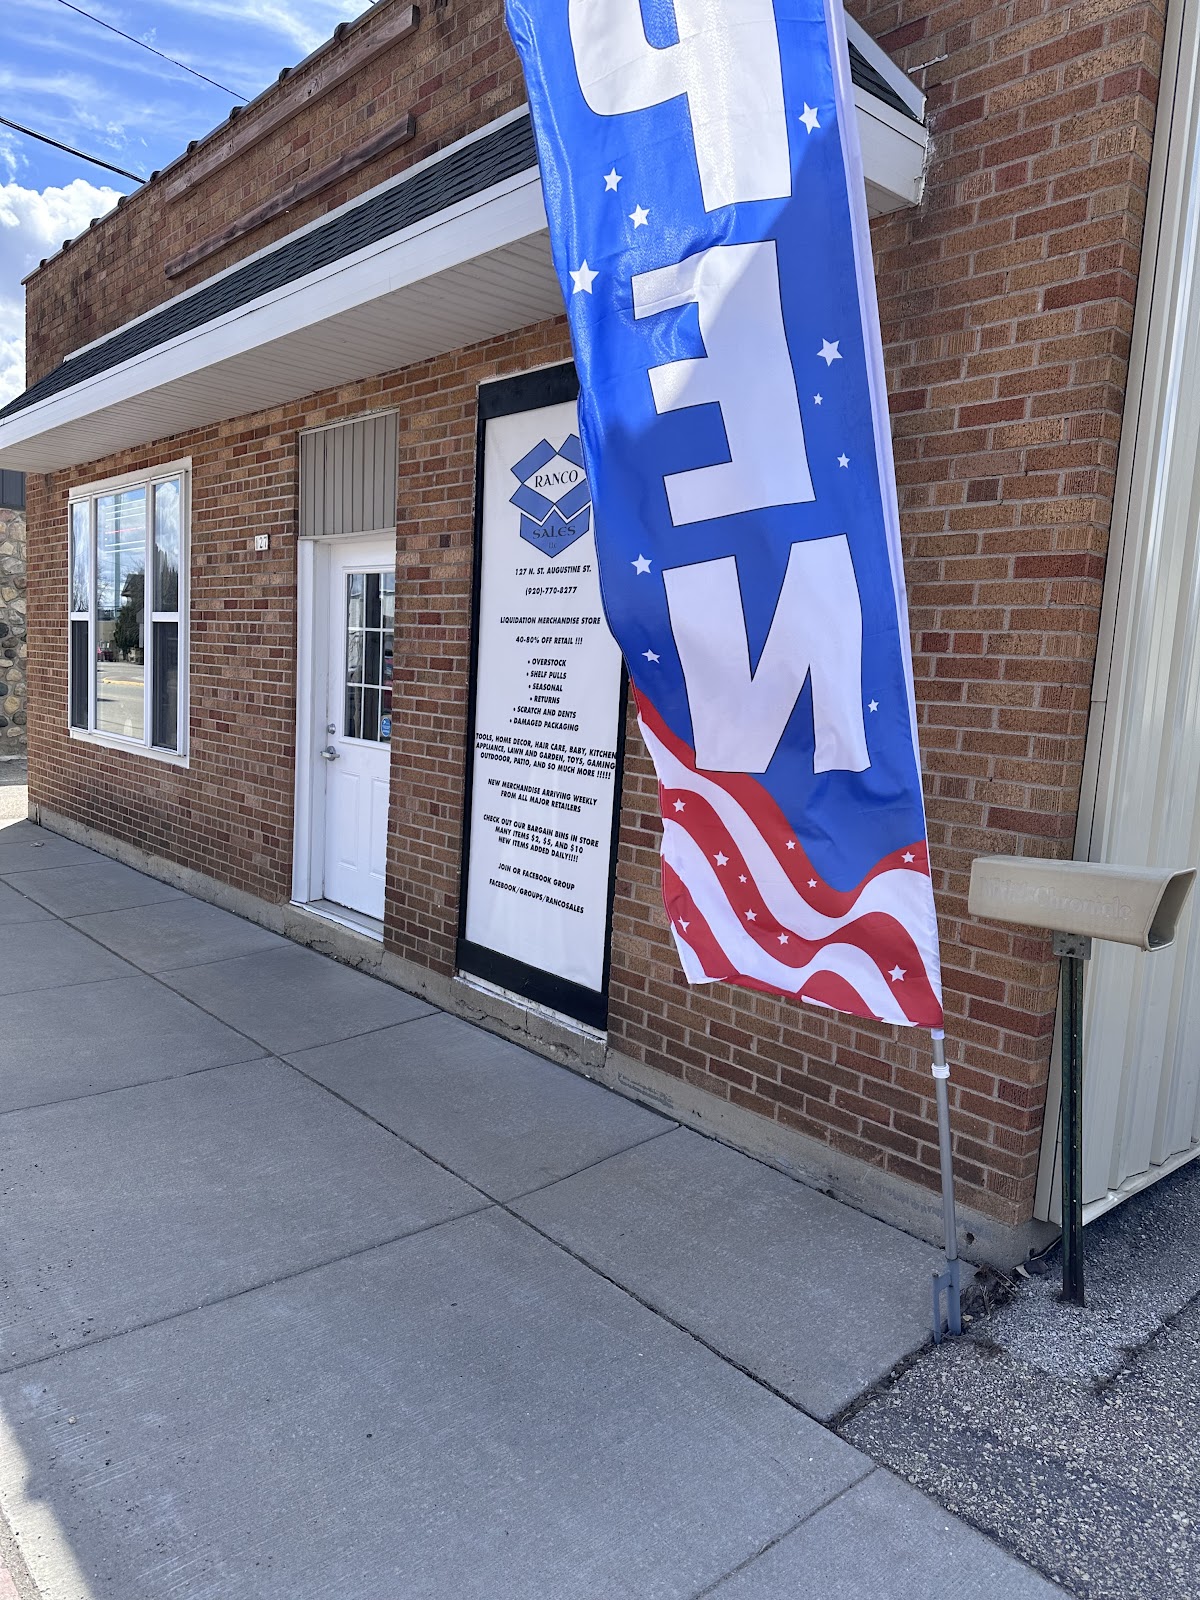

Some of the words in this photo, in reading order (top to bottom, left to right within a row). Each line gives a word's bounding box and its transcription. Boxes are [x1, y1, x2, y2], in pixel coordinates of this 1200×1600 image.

[534, 470, 578, 488] RANCO
[532, 526, 576, 539] SALES
[546, 565, 581, 574] AUGUSTINE
[582, 565, 592, 573] ST.
[526, 586, 578, 596] (920)-770-8277
[532, 658, 567, 667] OVERSTOCK
[530, 670, 548, 678] SHELF
[548, 671, 567, 680] PULLS
[532, 683, 563, 692] SEASONAL
[534, 695, 560, 704] RETURNS
[517, 706, 541, 715] SCRATCH
[542, 708, 556, 716] AND
[557, 710, 576, 719] DENTS
[513, 717, 542, 727] DAMAGED
[544, 721, 579, 732] PACKAGING
[476, 733, 494, 742] TOOLS,
[495, 736, 512, 744] HOME
[513, 738, 533, 748] DECOR,
[534, 741, 549, 750] HAIR
[550, 743, 567, 753] CARE,
[569, 746, 587, 756] BABY,
[589, 749, 617, 760] KITCHEN
[476, 742, 506, 754] APPLIANCE,
[507, 746, 524, 755] LAWN
[525, 749, 538, 758] AND
[539, 751, 565, 763] GARDEN,
[567, 756, 585, 766] TOYS,
[586, 759, 617, 770] GAMING
[513, 757, 531, 768] PATIO,
[533, 760, 546, 768] AND
[557, 764, 576, 774] MUCH
[576, 767, 595, 777] MORE
[488, 778, 501, 786] NEW
[501, 781, 540, 794] MERCHANDISE
[542, 788, 571, 800] ARRIVING
[573, 794, 598, 806] WEEKLY
[500, 790, 516, 799] FROM
[518, 794, 528, 802] ALL
[529, 796, 550, 806] MAJOR
[551, 800, 581, 813] RETAILERS
[483, 814, 500, 824] CHECK
[501, 818, 512, 826] OUT
[513, 821, 526, 830] OUR
[527, 824, 554, 836] BARGAIN
[554, 830, 569, 840] BINS
[570, 834, 578, 842] IN
[579, 836, 599, 848] STORE
[495, 826, 512, 835] MANY
[512, 830, 530, 840] ITEMS
[531, 834, 541, 844] $2,
[543, 837, 553, 847] $5,
[554, 840, 568, 850] AND
[570, 844, 583, 854] $10
[498, 836, 511, 845] NEW
[512, 839, 529, 849] ITEMS
[530, 844, 550, 855] ADDED
[498, 863, 512, 872] JOIN
[512, 867, 521, 875] OR
[522, 870, 552, 884] FACEBOOK
[553, 879, 575, 890] GROUP
[489, 878, 584, 914] FACEBOOK/GROUPS/RANCOSALES
